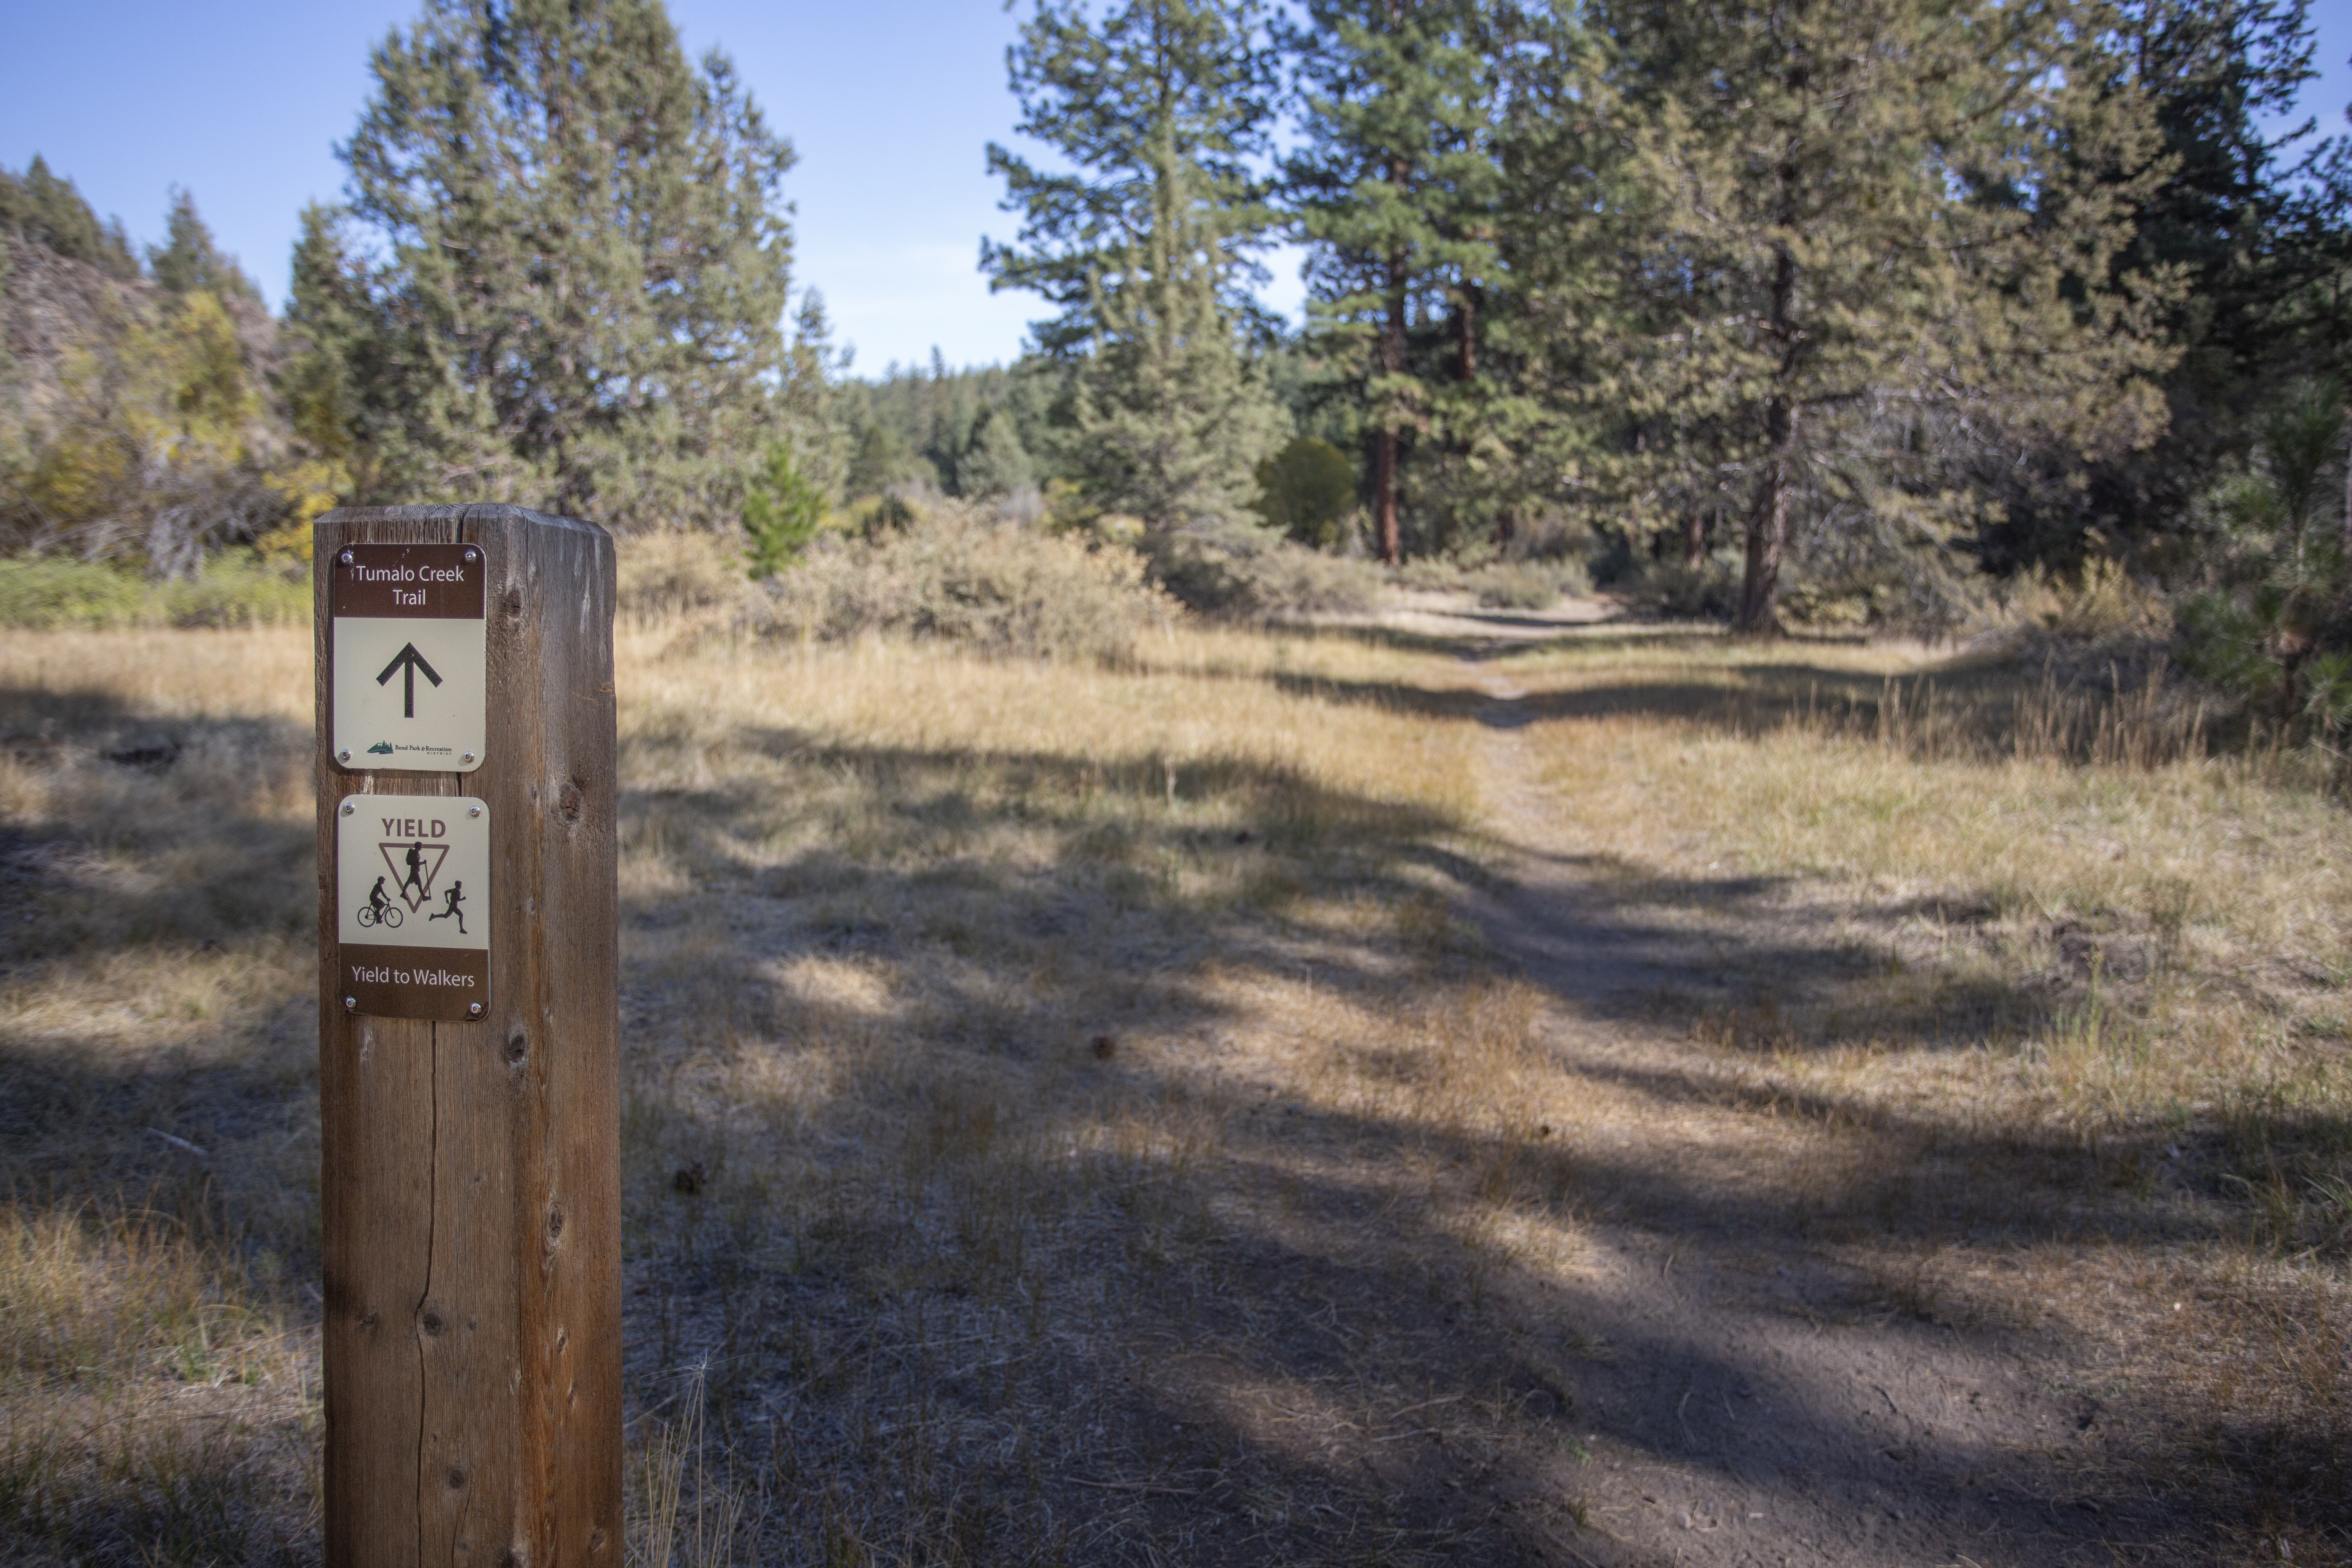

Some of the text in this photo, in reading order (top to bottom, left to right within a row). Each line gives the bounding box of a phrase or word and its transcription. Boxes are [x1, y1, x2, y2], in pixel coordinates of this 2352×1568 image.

[356, 565, 464, 581] Tumalo Creek
[392, 589, 426, 605] Trail
[381, 818, 446, 838] YIELD
[351, 966, 475, 987] Yield to Walkers
